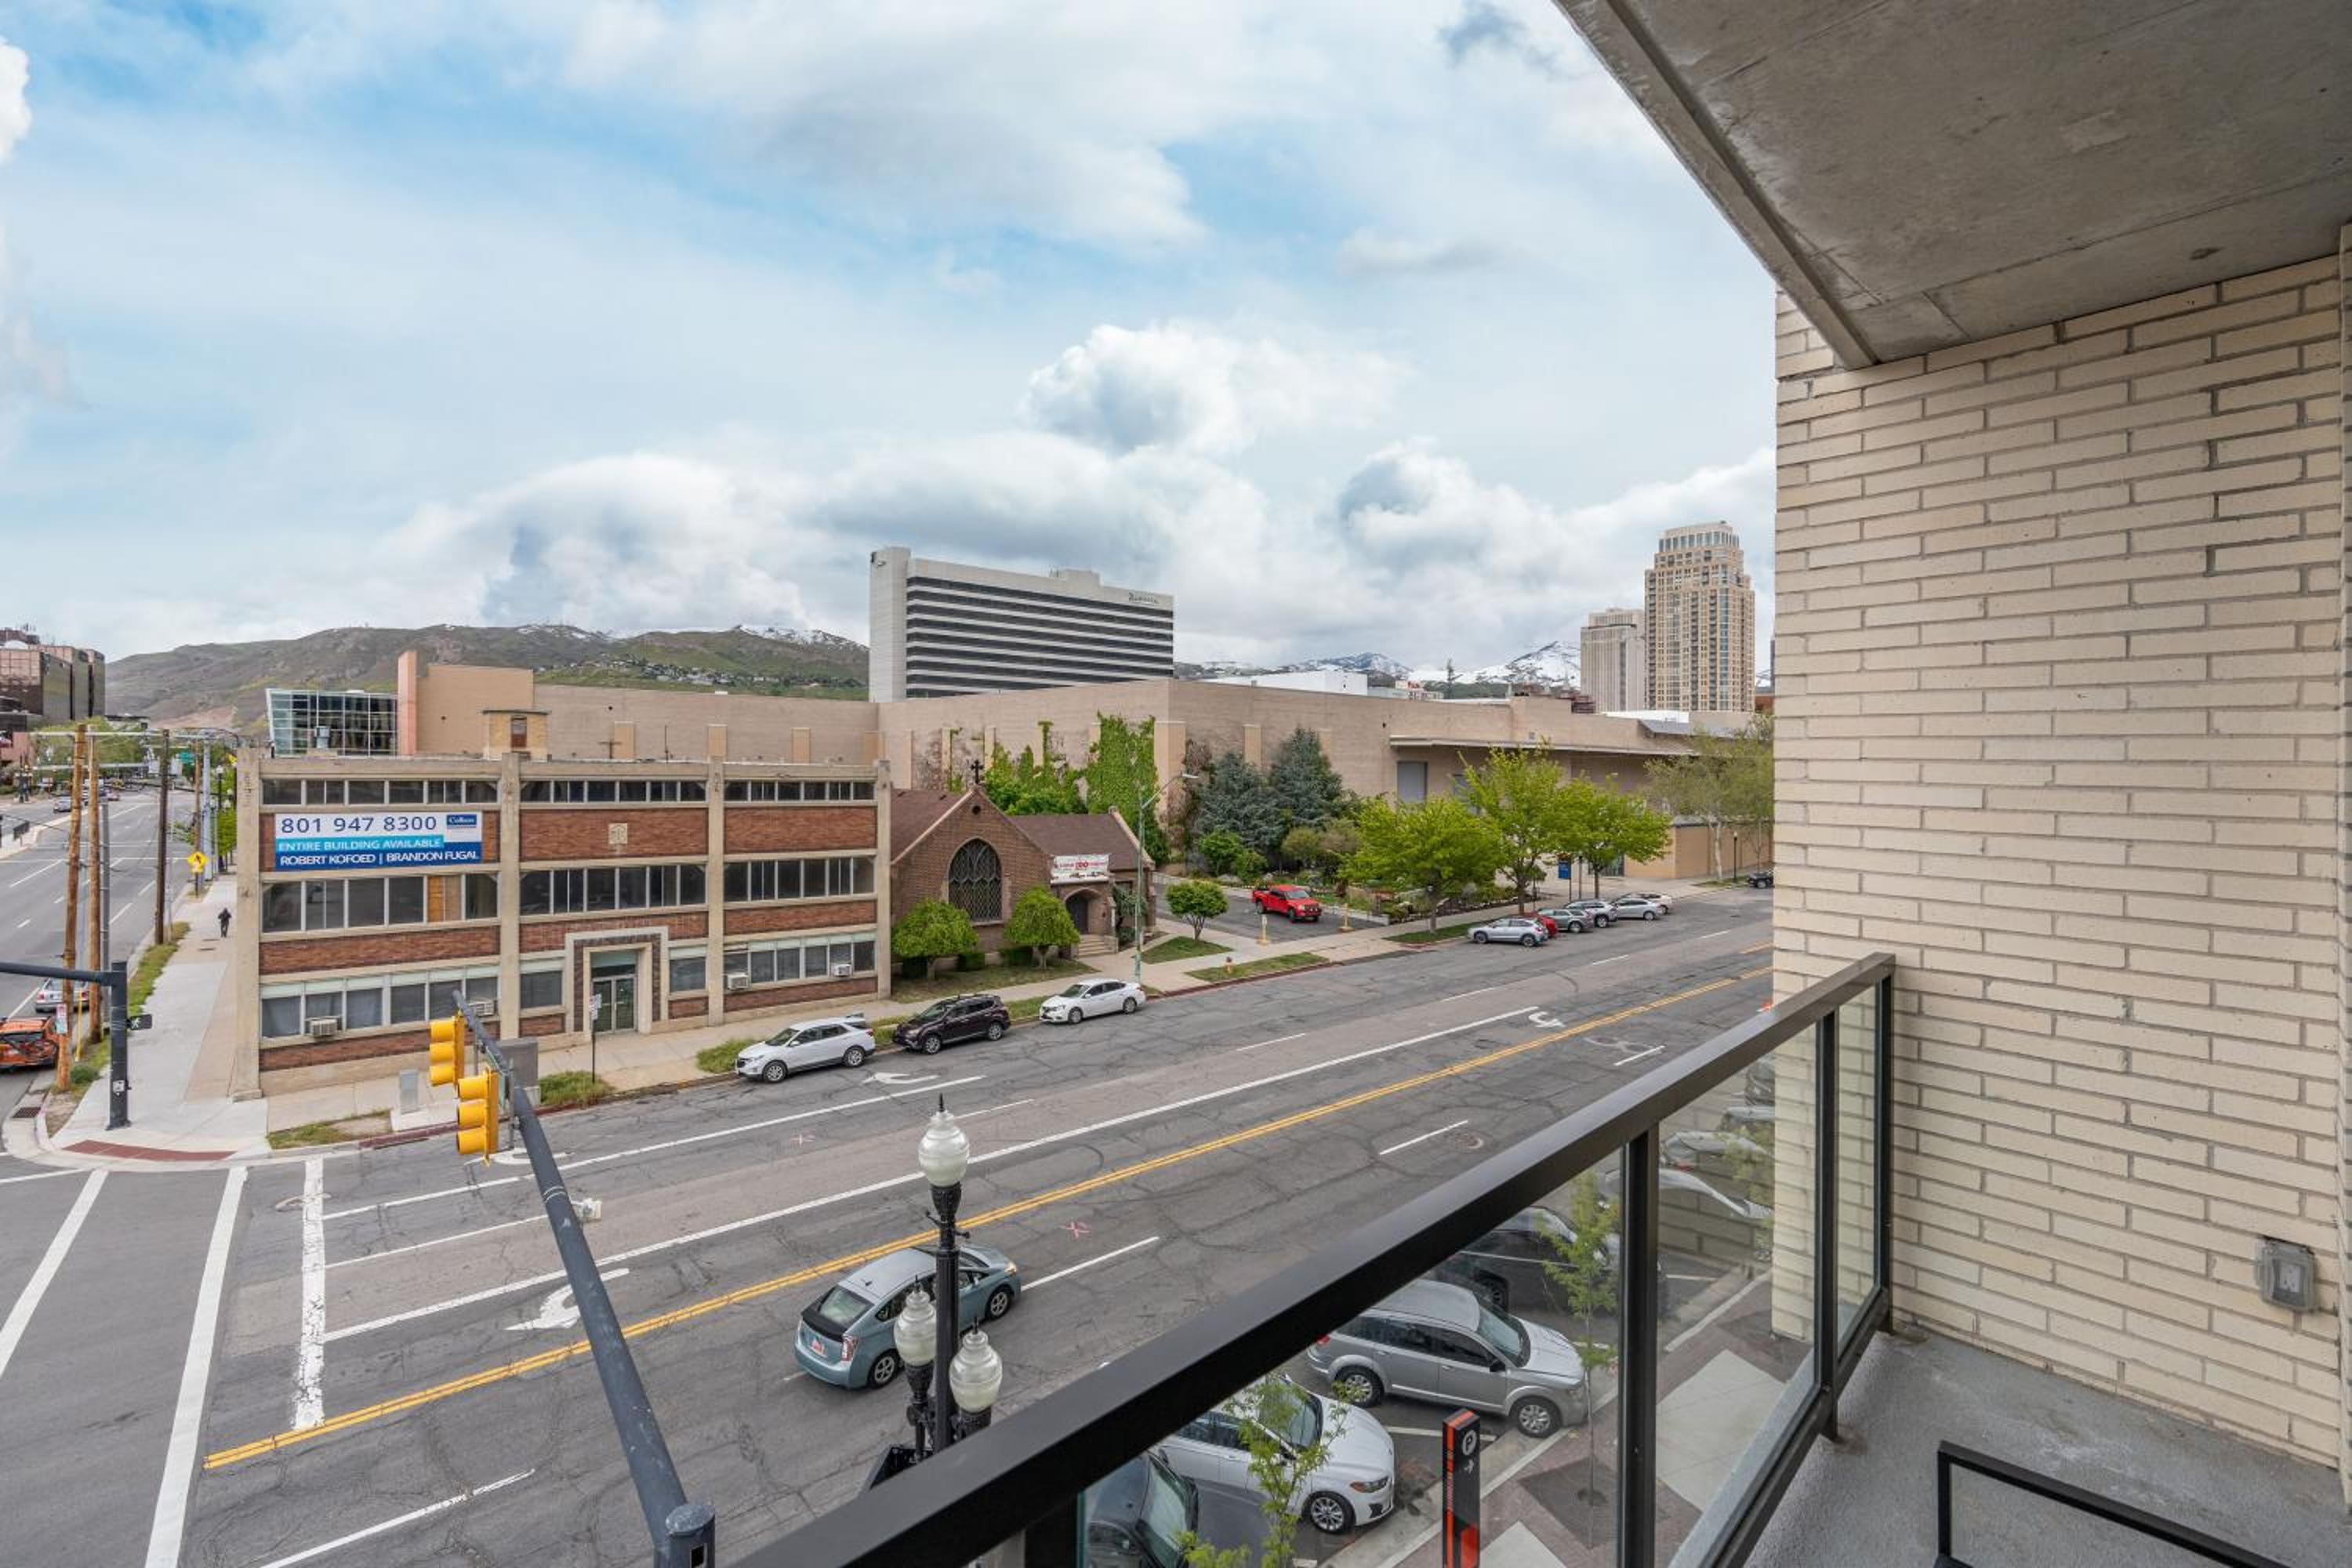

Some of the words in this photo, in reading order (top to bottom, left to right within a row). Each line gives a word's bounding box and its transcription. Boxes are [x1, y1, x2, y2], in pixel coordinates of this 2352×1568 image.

[281, 818, 321, 833] 801
[334, 816, 374, 832] 947
[383, 816, 437, 832] 8300
[278, 842, 321, 852] ENTIRE
[324, 840, 380, 851] BUILDING
[383, 839, 441, 849] AVAILABLE
[280, 855, 326, 866] ROBERT
[329, 853, 376, 865] KOFOED
[387, 851, 443, 862] BRANDON
[445, 850, 480, 861] FUGAL
